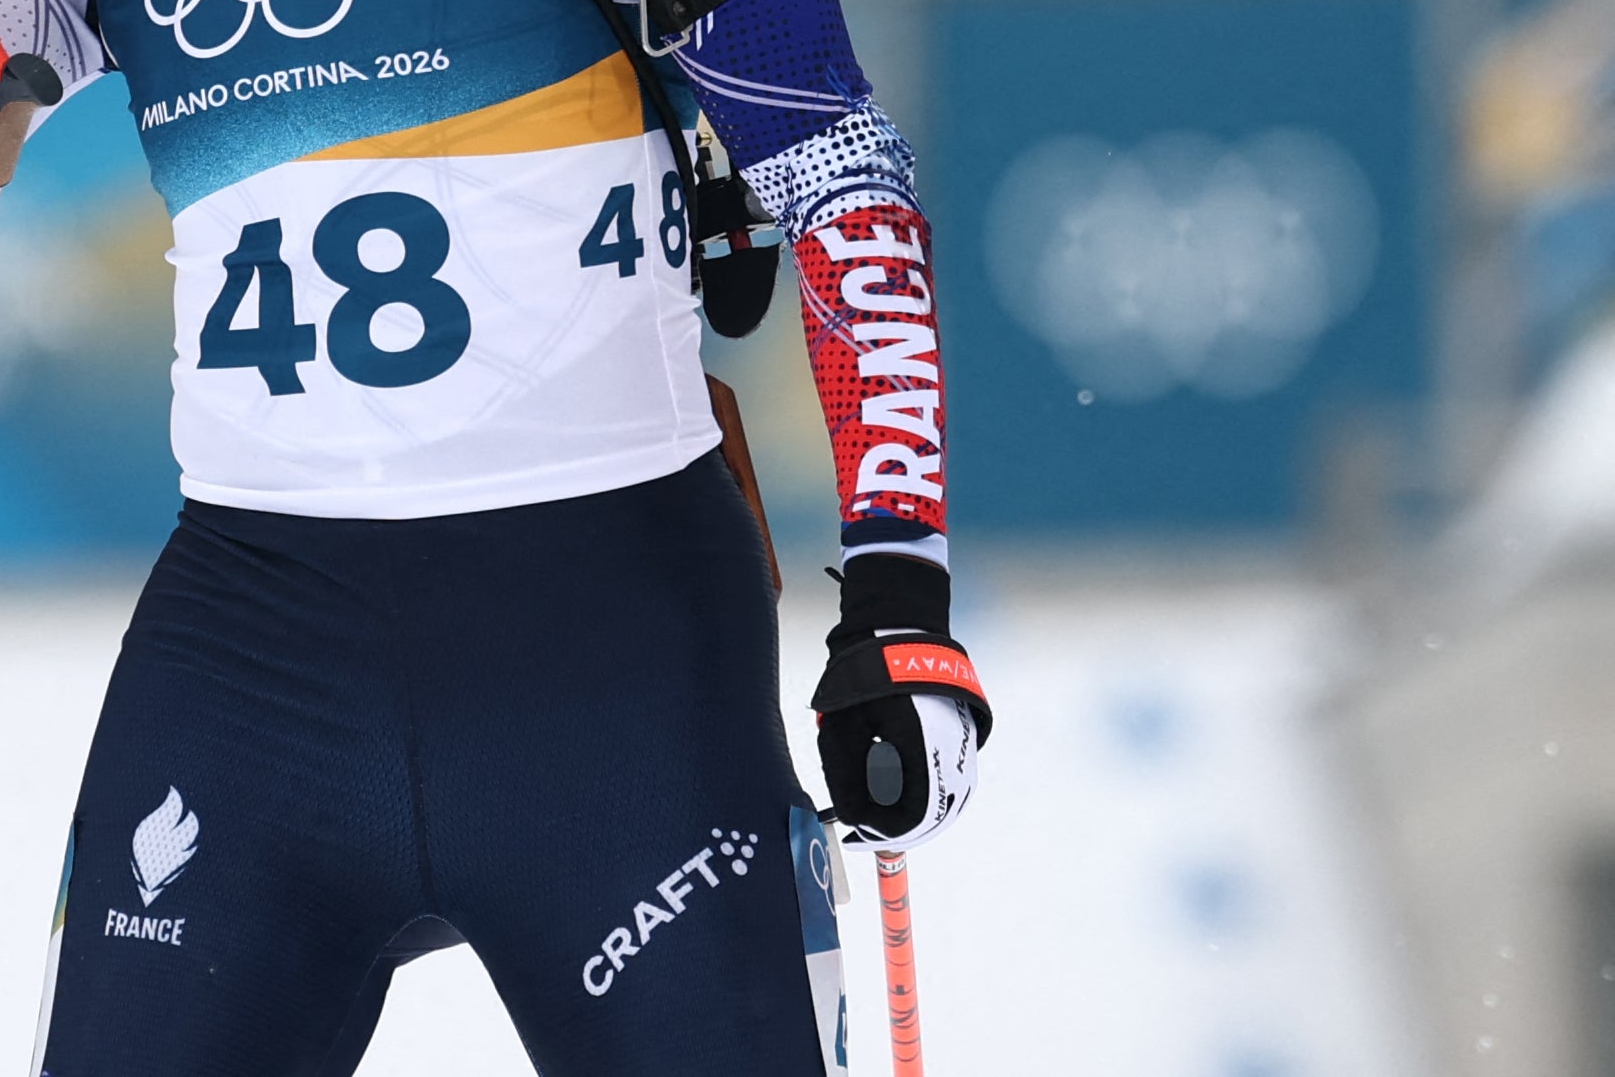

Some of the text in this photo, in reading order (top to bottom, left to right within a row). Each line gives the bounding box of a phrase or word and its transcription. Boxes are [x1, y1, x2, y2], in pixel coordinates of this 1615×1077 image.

[142, 48, 450, 131] MILANO CORTINA 2026
[578, 170, 687, 279] 48
[196, 191, 472, 397] 48
[104, 908, 186, 947] FRANCE
[583, 847, 721, 997] CRAFT
